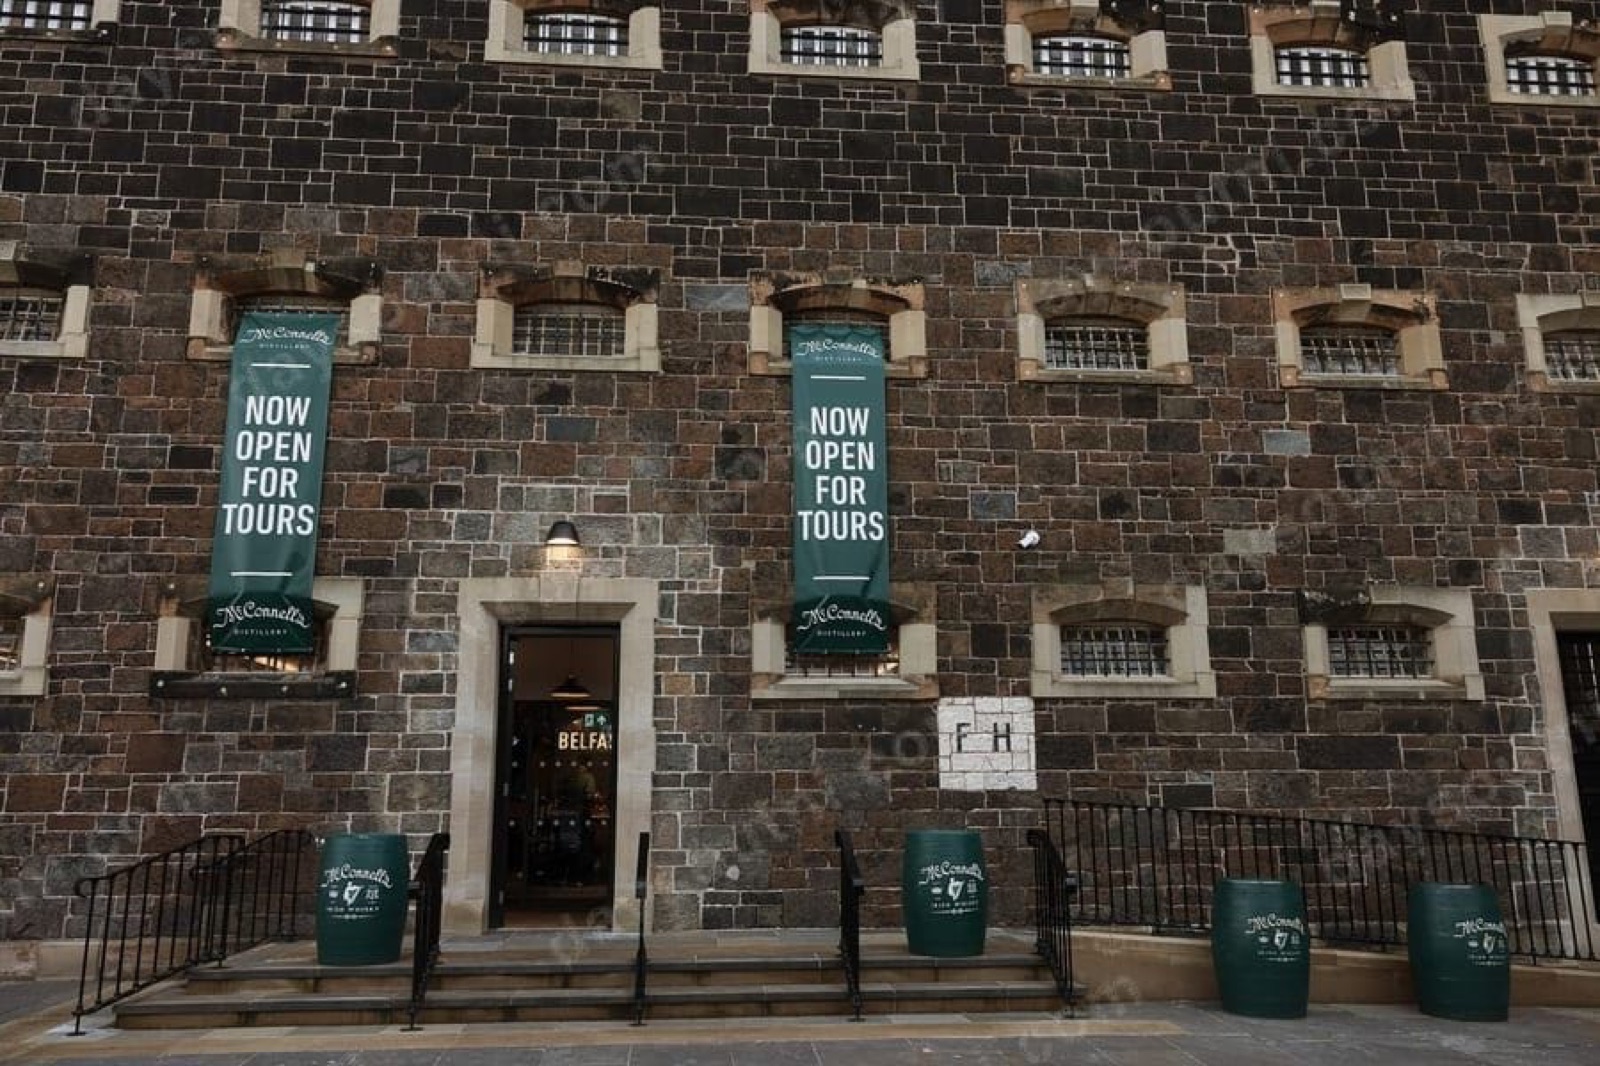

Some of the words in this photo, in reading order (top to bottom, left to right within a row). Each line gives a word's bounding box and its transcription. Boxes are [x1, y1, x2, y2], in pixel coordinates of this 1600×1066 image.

[245, 396, 311, 426] NOW
[810, 406, 869, 436] NOW
[236, 430, 312, 462] OPEN
[806, 440, 875, 471] OPEN
[242, 467, 299, 498] FOR
[815, 475, 867, 505] FOR
[222, 503, 315, 535] TOURS
[798, 510, 884, 541] TOURS
